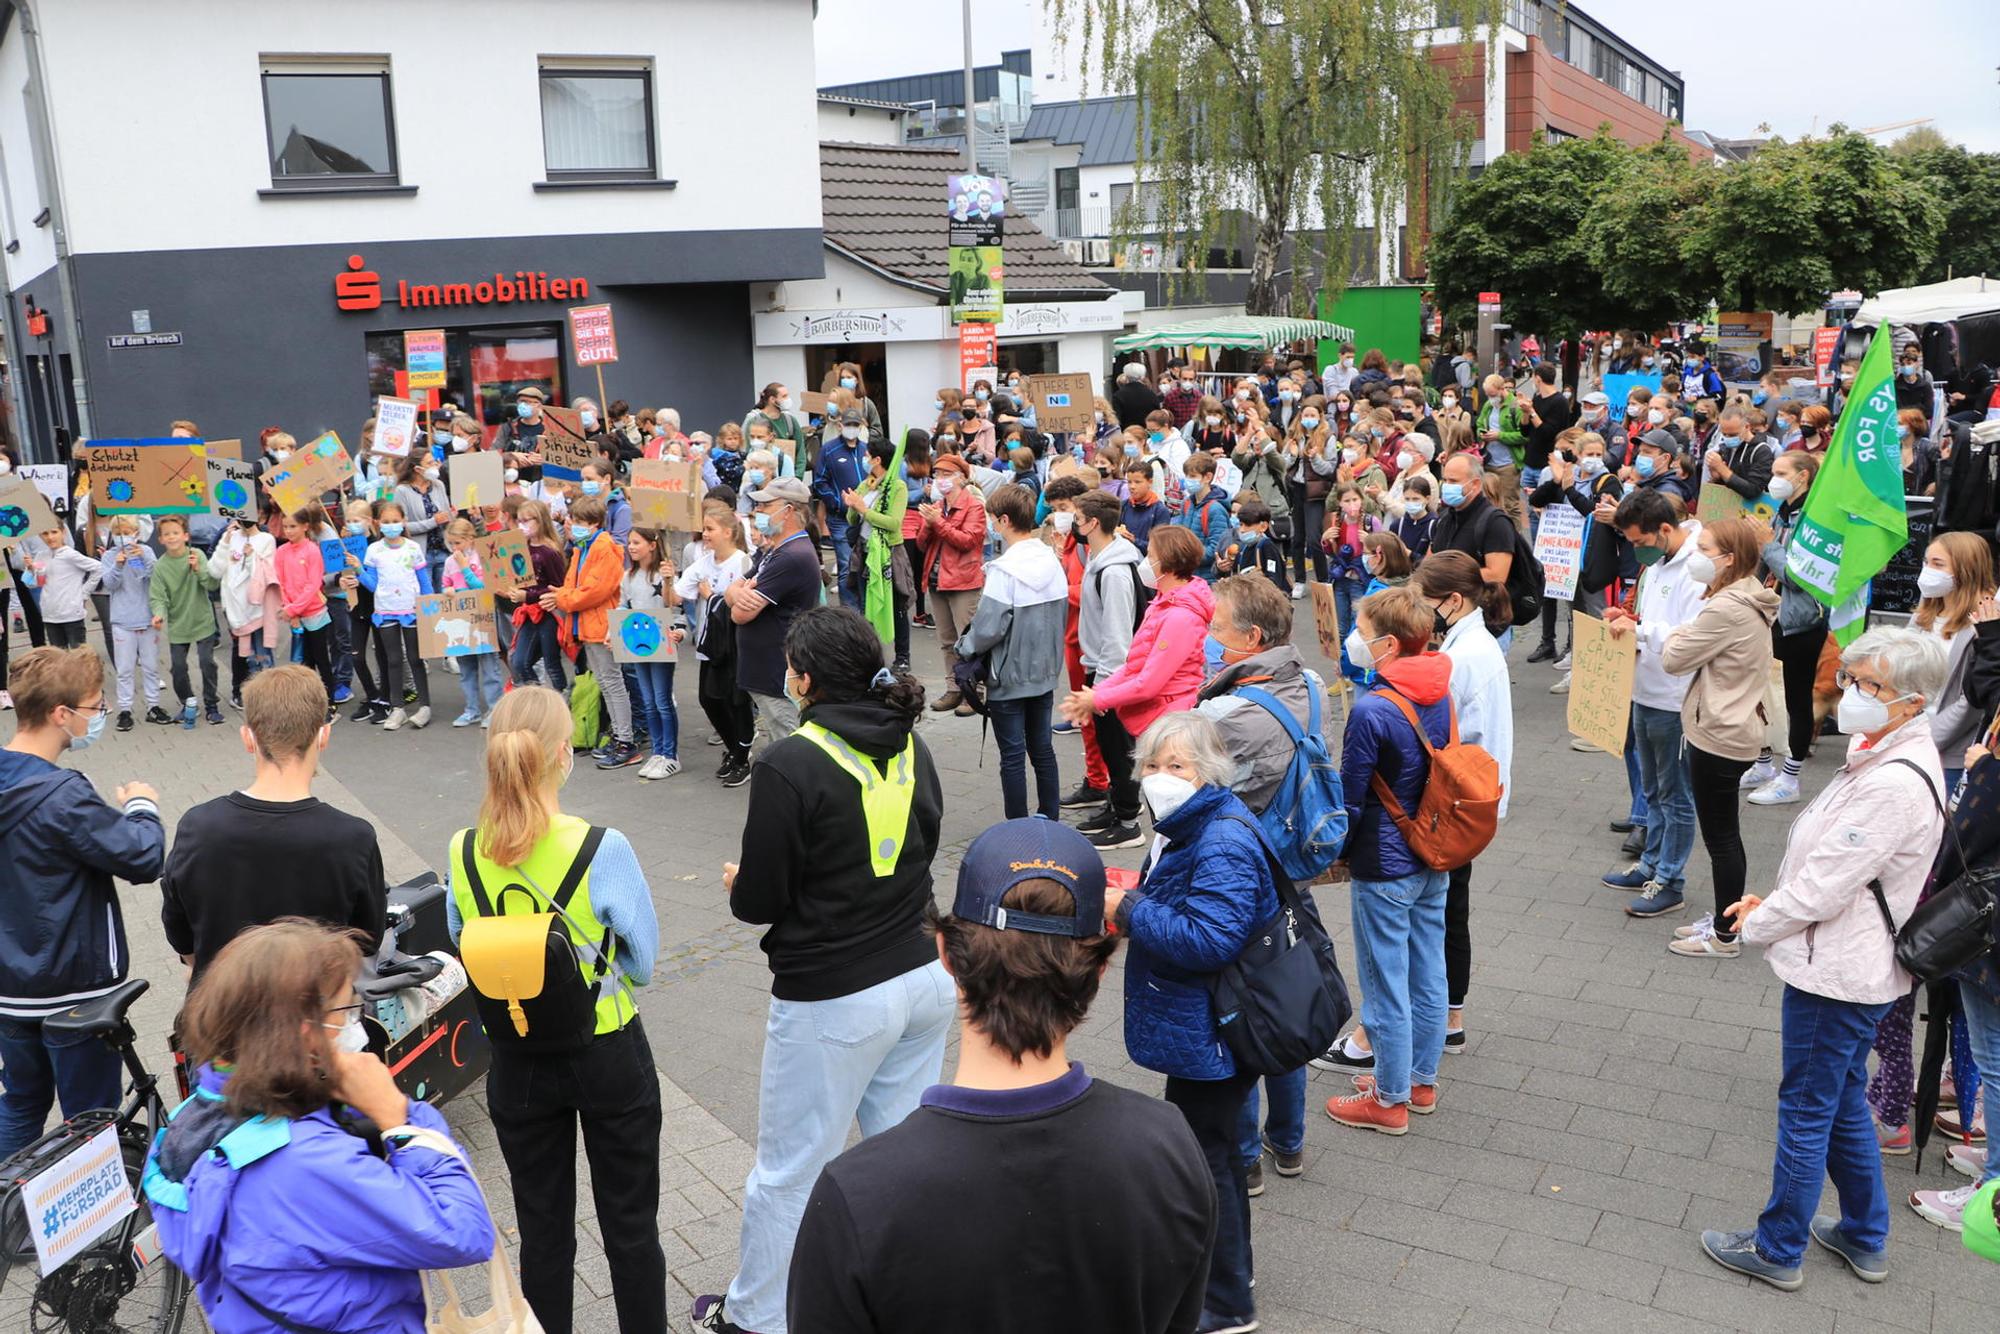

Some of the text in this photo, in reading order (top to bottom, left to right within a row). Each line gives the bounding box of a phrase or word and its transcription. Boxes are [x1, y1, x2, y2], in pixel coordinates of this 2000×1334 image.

[398, 271, 588, 308] Immobilien
[575, 317, 609, 328] ERDE
[811, 318, 881, 336] BARBERSHOP
[576, 329, 592, 338] SIE
[112, 337, 126, 346] Auf
[127, 337, 145, 345] dem
[577, 336, 610, 349] SEHR
[1033, 378, 1085, 392] THERE IS
[1038, 417, 1073, 433] PLANET
[207, 460, 221, 471] No
[1801, 523, 1823, 547] Wir
[61, 1172, 122, 1227] FÜRSRAD
